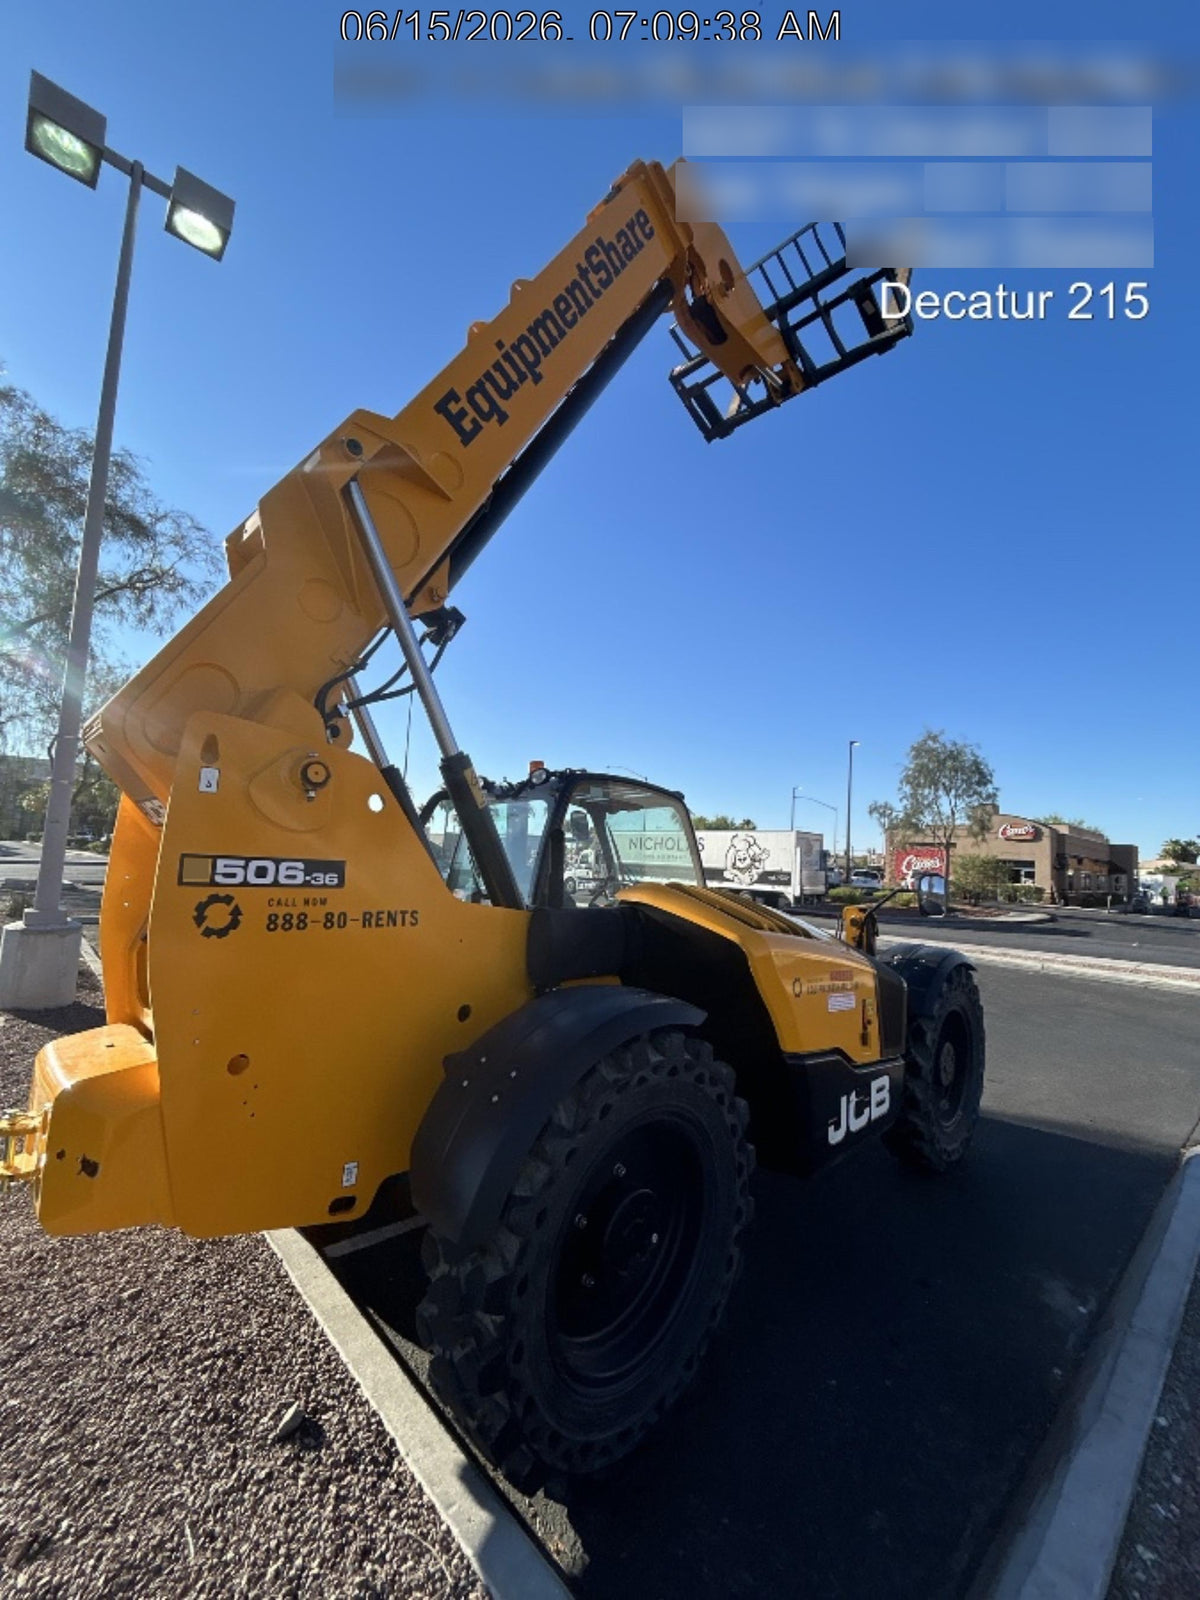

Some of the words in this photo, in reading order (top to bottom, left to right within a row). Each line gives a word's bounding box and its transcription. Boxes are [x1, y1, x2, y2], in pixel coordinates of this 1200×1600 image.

[433, 208, 655, 448] EquipmentShare
[628, 836, 705, 852] NICHOLS
[214, 859, 339, 885] 506-36
[268, 898, 298, 908] CALL
[303, 897, 328, 907] NOW
[266, 910, 419, 932] 888-80-RENTS
[827, 1075, 889, 1144] JCB
